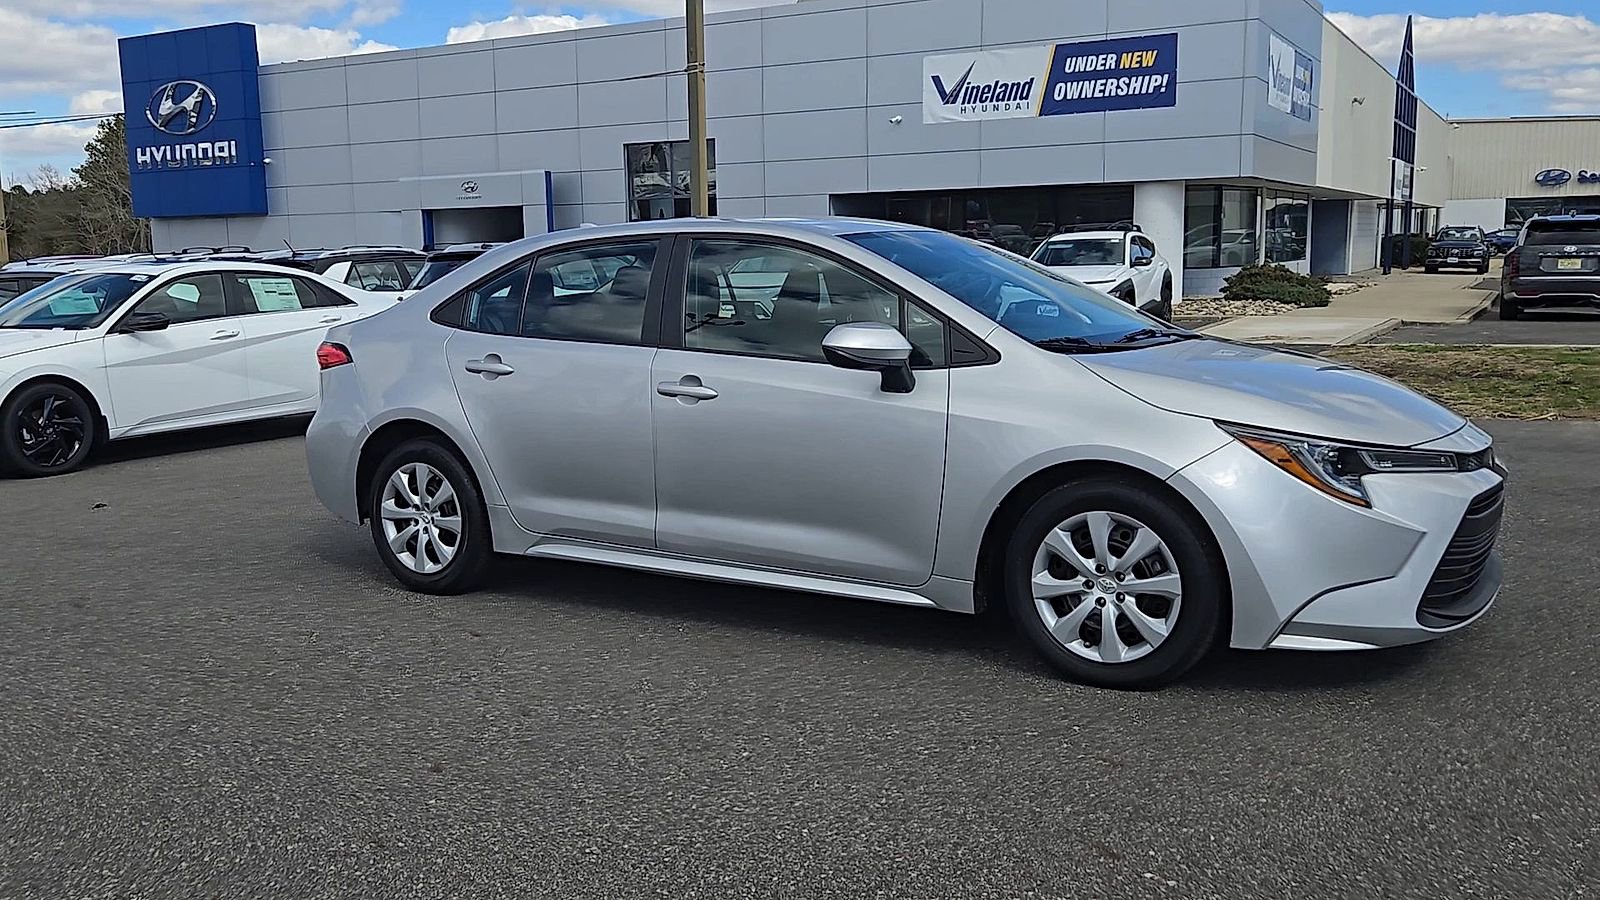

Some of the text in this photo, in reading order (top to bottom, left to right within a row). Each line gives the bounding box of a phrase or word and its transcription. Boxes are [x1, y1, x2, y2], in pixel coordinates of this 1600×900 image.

[1064, 50, 1158, 73] UNDER NEW
[930, 60, 1035, 105] Vineland
[1053, 74, 1169, 101] OWNERSHIP!
[960, 102, 1030, 114] HYUNDAI
[136, 141, 236, 169] HYUNDAI
[1577, 170, 1600, 184] Se
